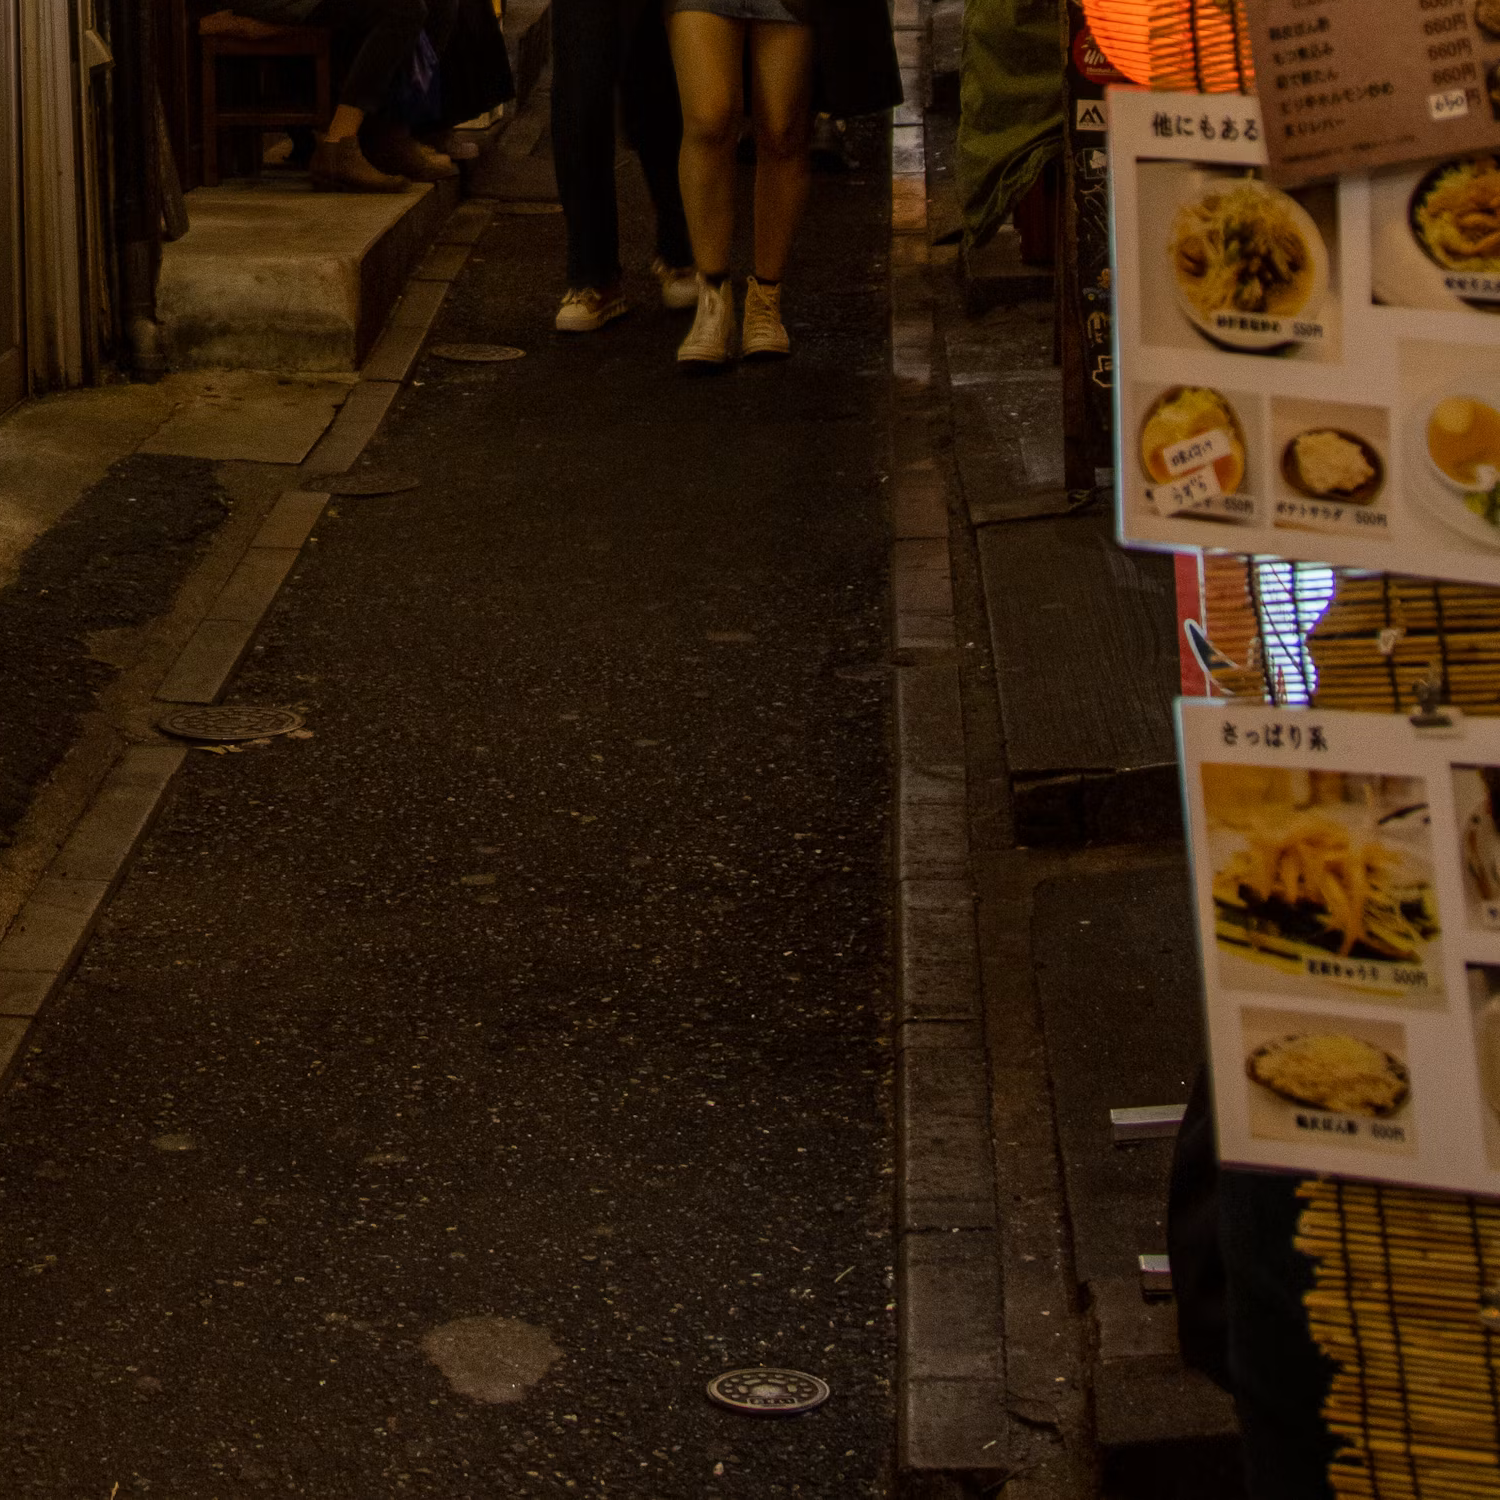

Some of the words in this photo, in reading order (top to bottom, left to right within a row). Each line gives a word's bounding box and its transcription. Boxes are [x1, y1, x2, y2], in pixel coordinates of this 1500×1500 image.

[1153, 112, 1259, 140] 他にもある
[1276, 500, 1344, 522] ポテトサラダ
[1355, 506, 1388, 526] 500円
[1221, 719, 1329, 753] さっぱり系
